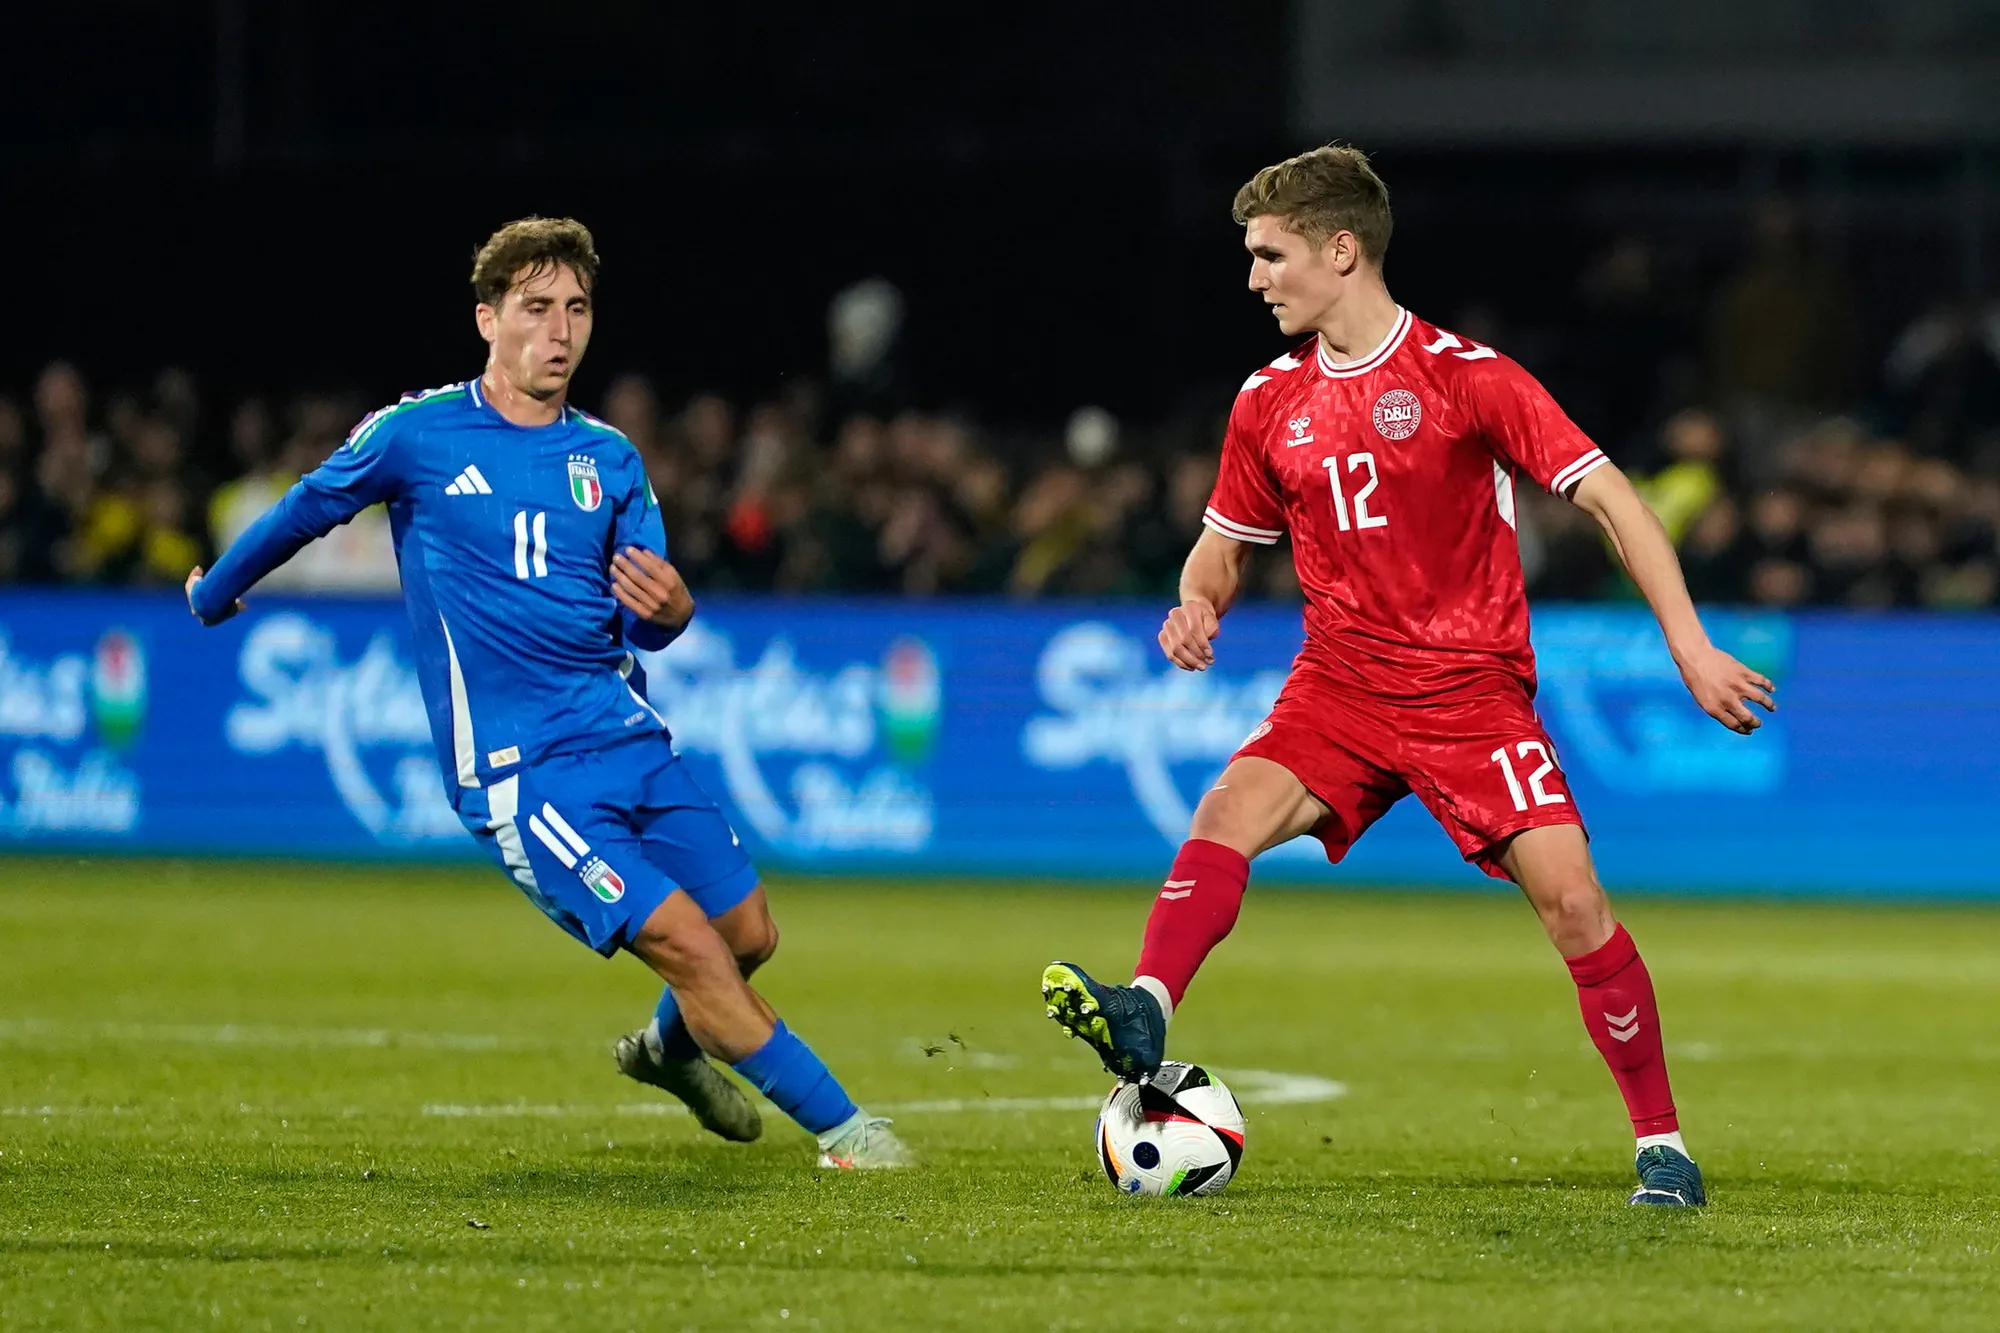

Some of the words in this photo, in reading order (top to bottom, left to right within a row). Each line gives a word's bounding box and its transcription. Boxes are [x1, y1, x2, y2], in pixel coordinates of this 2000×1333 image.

[1375, 406, 1389, 434] DANSK
[1383, 406, 1413, 422] DBU
[571, 465, 596, 477] ITALIA
[1322, 452, 1388, 532] 12
[514, 510, 548, 580] 11
[1490, 741, 1567, 812] 12
[528, 801, 592, 870] 11
